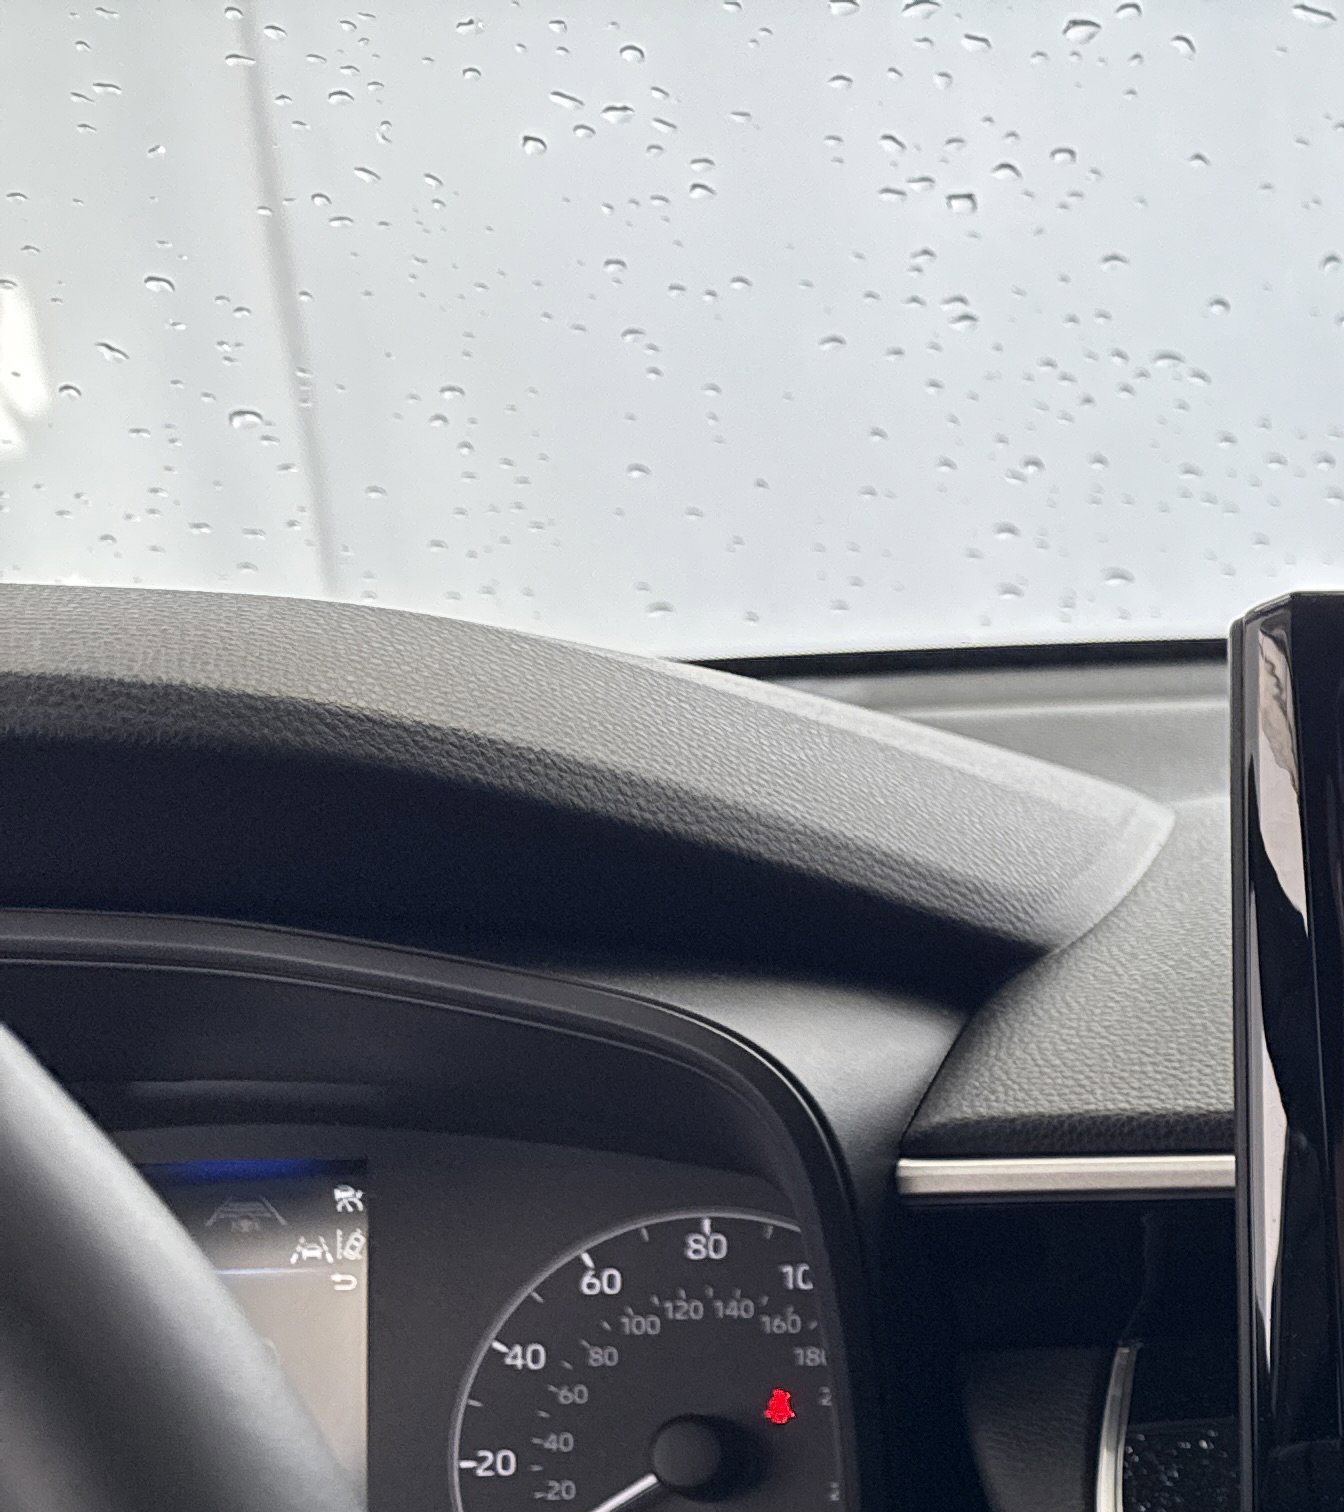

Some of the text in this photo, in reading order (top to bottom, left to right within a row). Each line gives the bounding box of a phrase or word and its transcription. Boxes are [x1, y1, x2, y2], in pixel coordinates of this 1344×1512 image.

[684, 1232, 728, 1260] 80
[579, 1267, 623, 1295] 60
[663, 1299, 705, 1321] 120
[713, 1298, 755, 1319] 140
[618, 1314, 662, 1336] 100
[759, 1312, 803, 1335] 160
[503, 1343, 547, 1371] 40
[587, 1345, 620, 1368] 80
[556, 1383, 590, 1405] 60
[543, 1431, 575, 1453] 40
[474, 1449, 518, 1477] 20
[546, 1479, 577, 1500] 20
